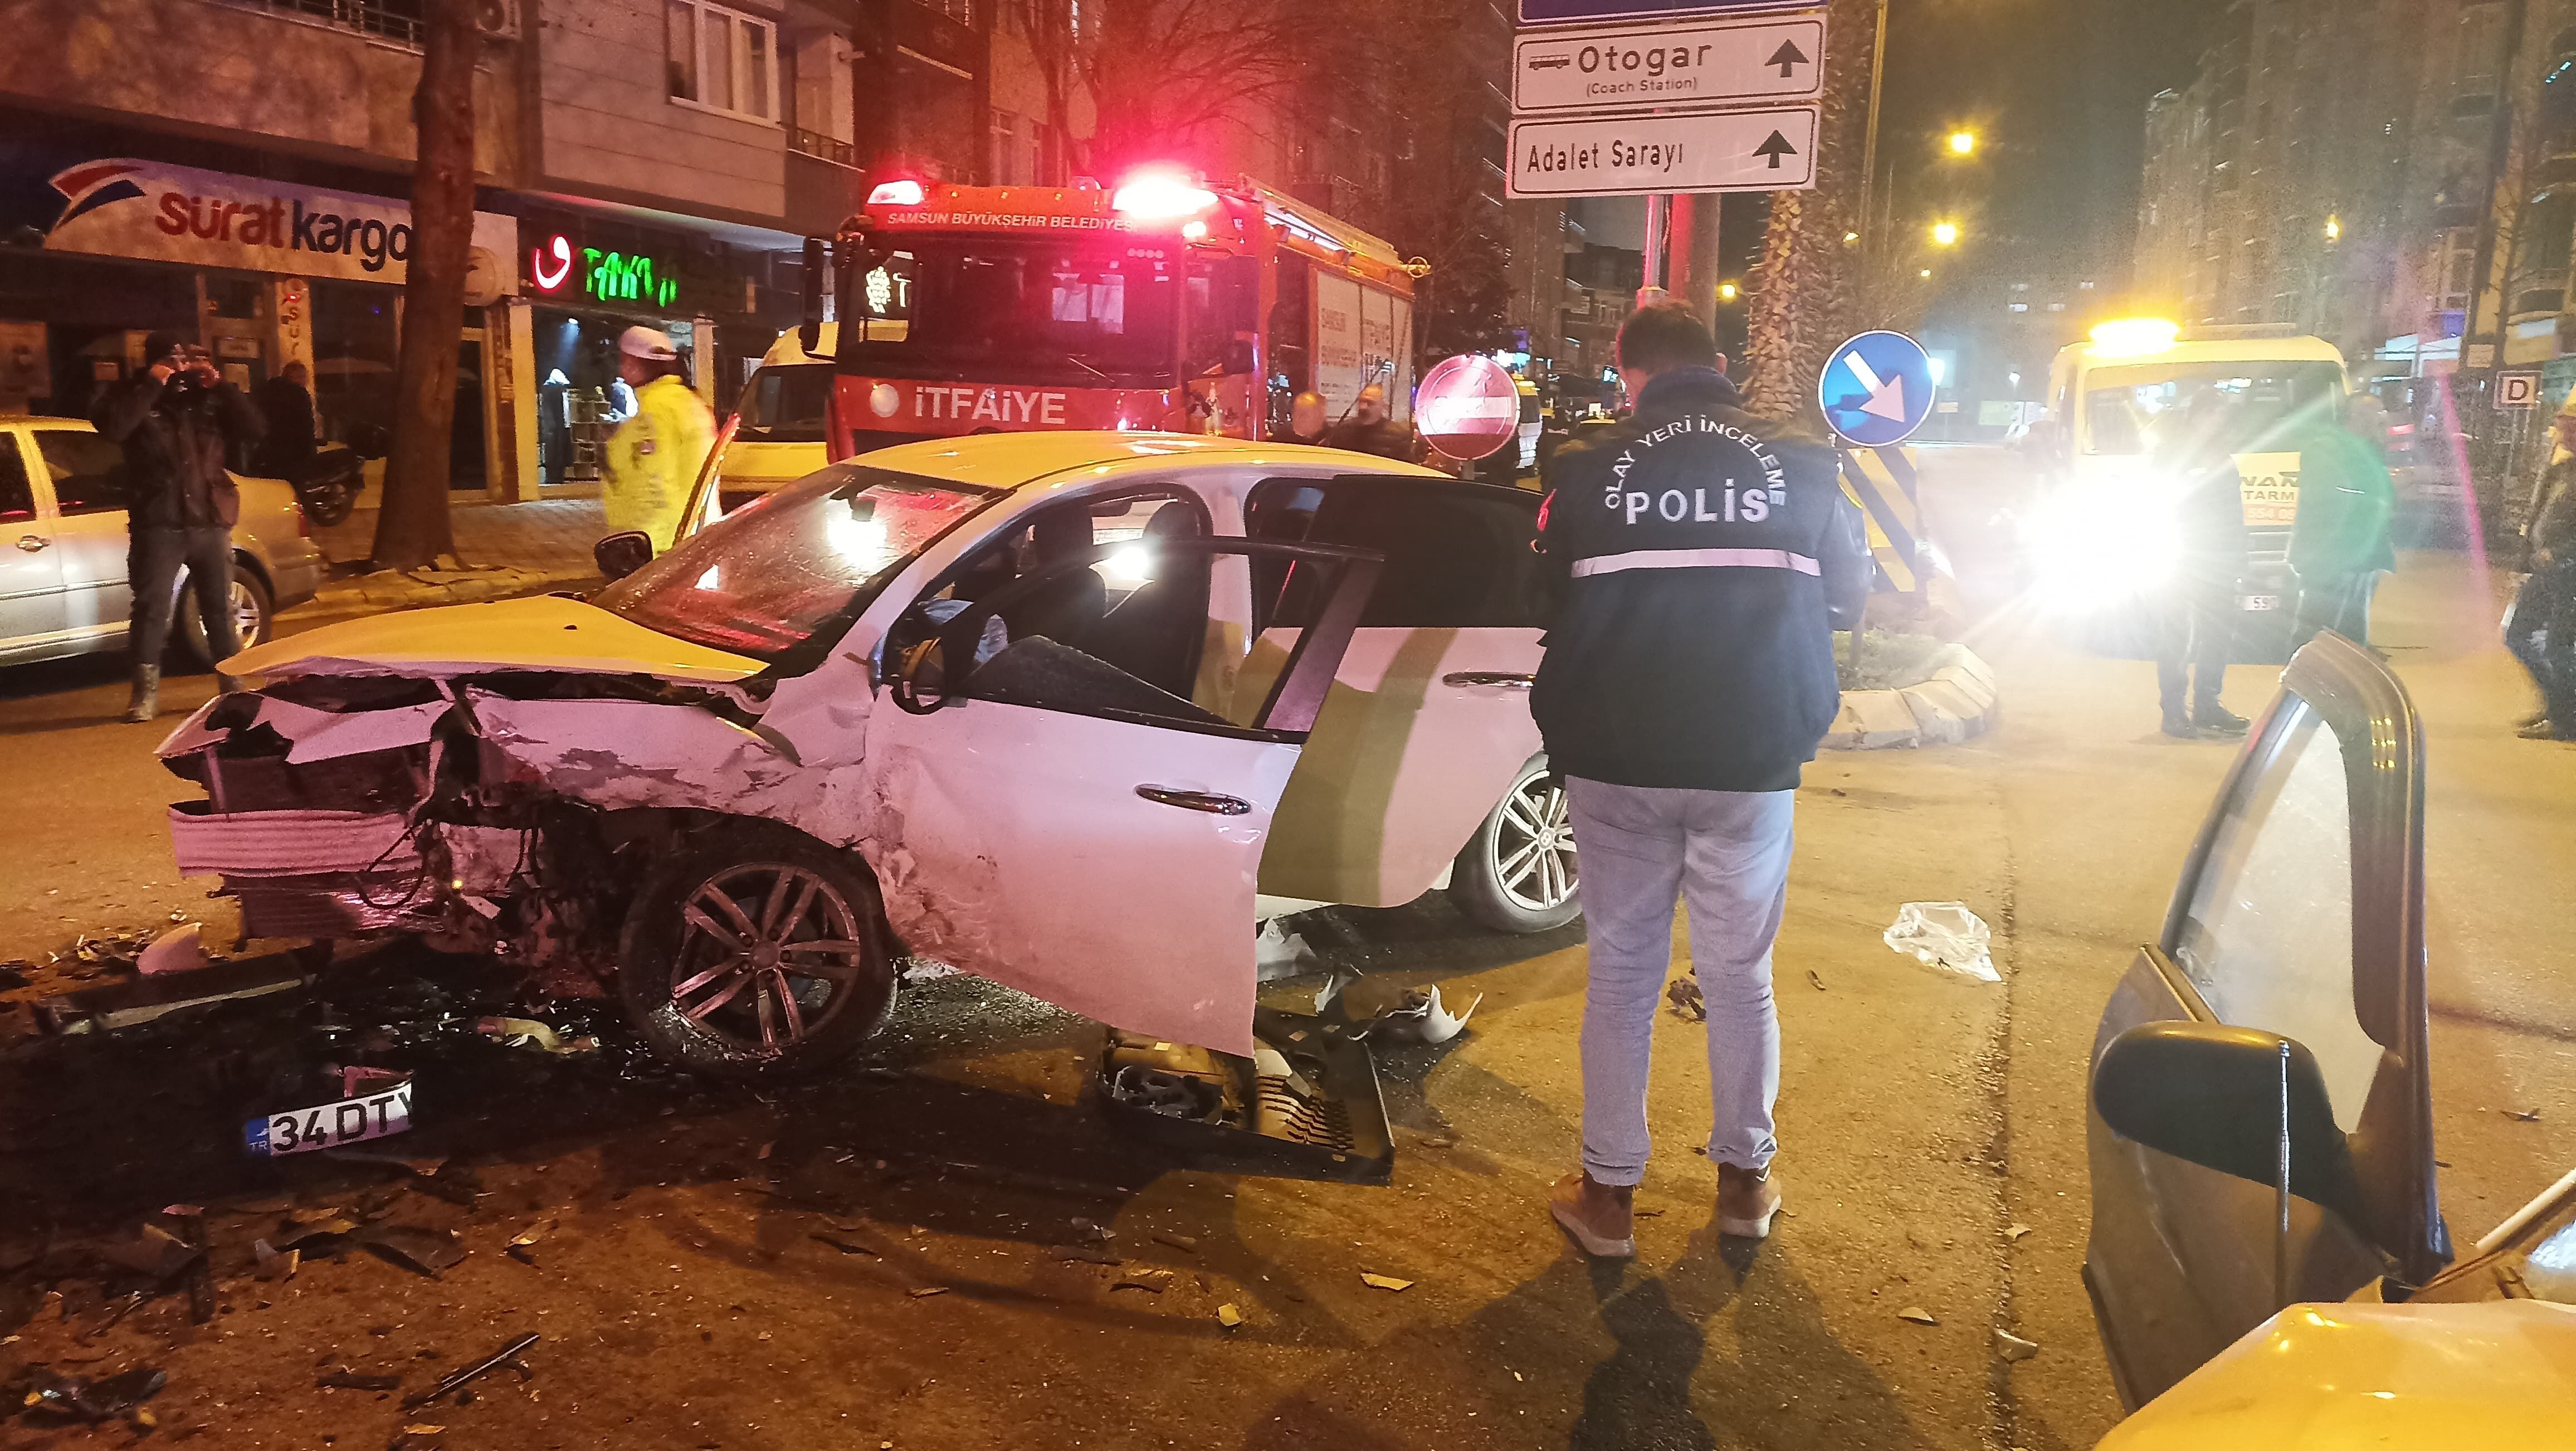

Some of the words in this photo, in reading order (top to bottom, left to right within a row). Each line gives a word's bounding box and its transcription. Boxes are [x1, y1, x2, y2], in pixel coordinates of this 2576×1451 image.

[1577, 44, 1713, 77] Otogar
[1587, 81, 1635, 98] (Coach
[1640, 77, 1698, 91] Station)
[1526, 142, 1599, 173] Adalet
[1611, 139, 1684, 173] Sarayı
[887, 212, 949, 225] SAMSUN
[952, 211, 1048, 228] BÜYÜKŞEHİR
[1050, 216, 1136, 232] BELEDİYES
[915, 386, 1066, 425] İTFAİYE
[2508, 379, 2529, 401] D
[1604, 449, 1636, 509] OLAY
[1633, 414, 1692, 447] YERİ
[1700, 413, 1787, 507] İNCELEME
[1626, 478, 1770, 525] POLİS
[2243, 490, 2295, 500] TARM
[272, 1109, 328, 1152] 34
